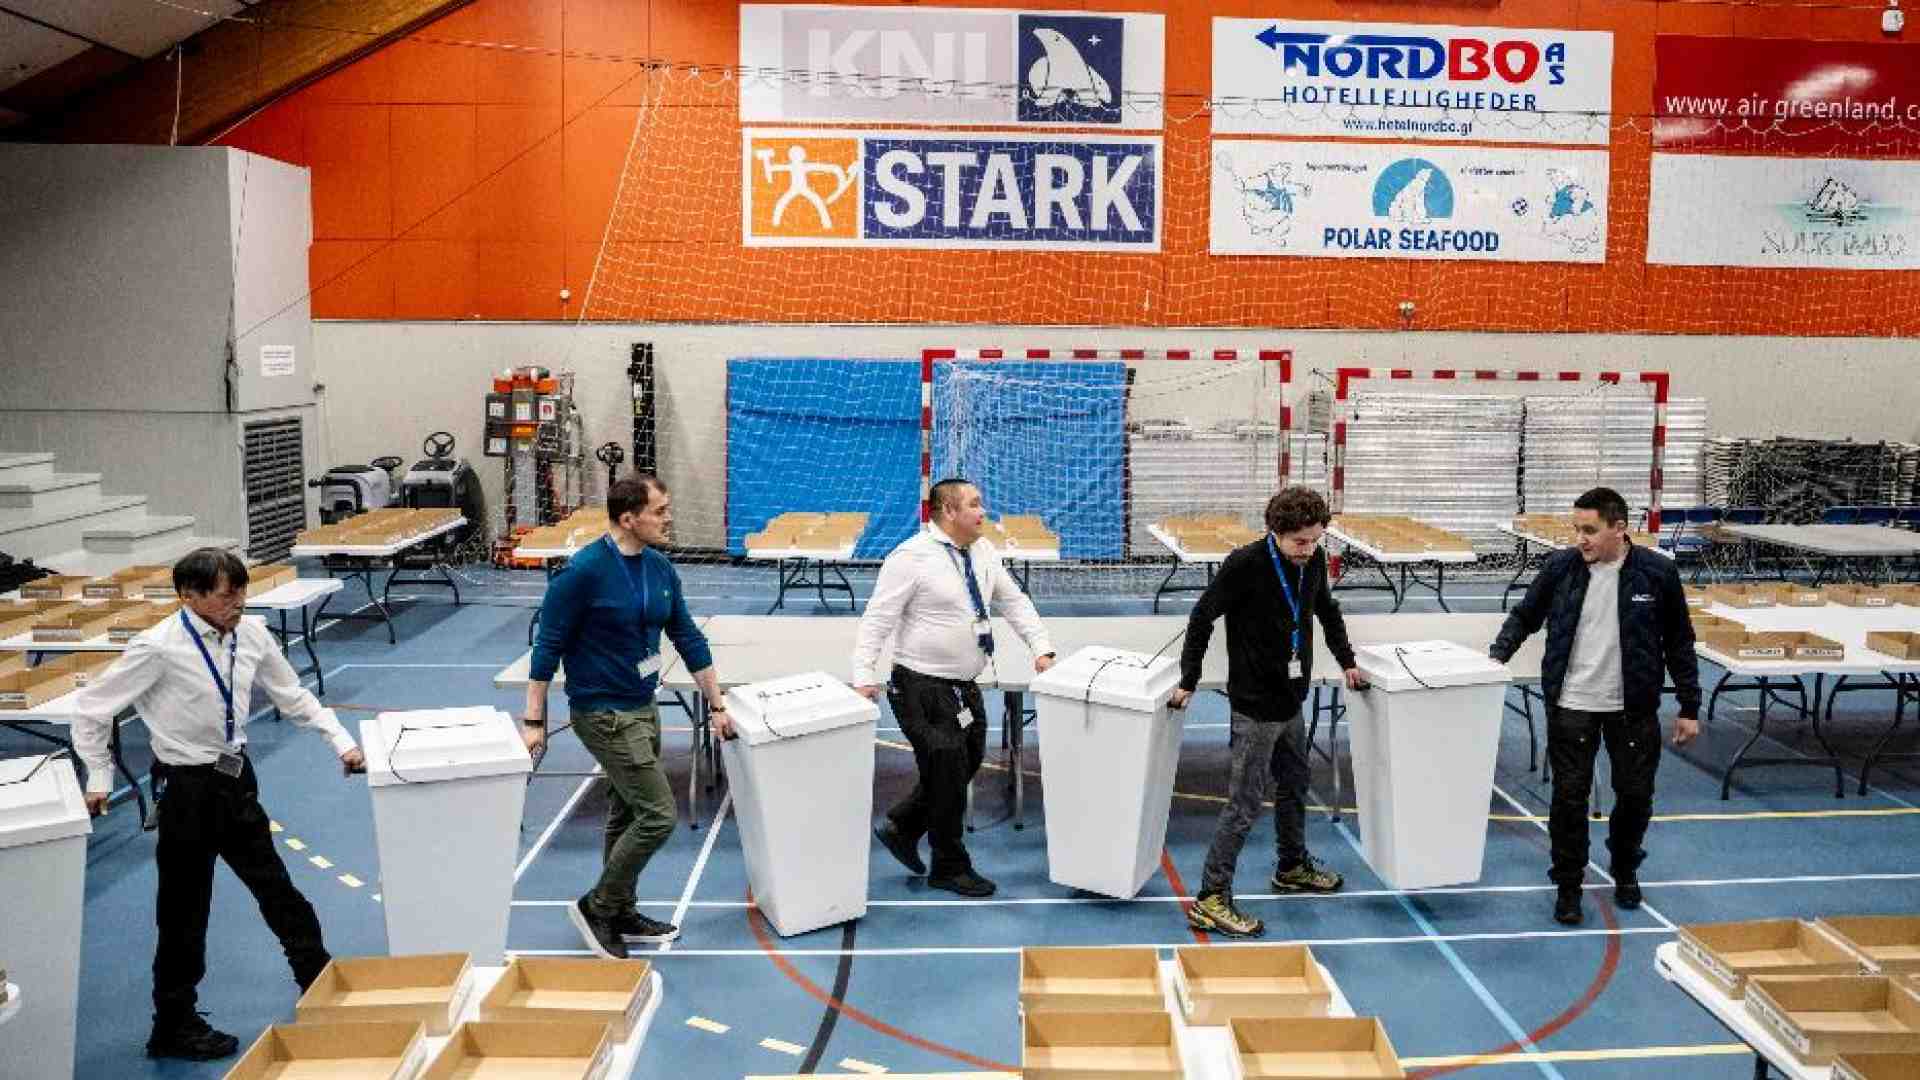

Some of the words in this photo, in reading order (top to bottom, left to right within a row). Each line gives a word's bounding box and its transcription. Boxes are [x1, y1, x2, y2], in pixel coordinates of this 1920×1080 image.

[807, 28, 989, 98] KNI
[1283, 38, 1540, 83] NORDBO
[1283, 86, 1536, 112] HOTELLEJLIGHEDER
[875, 148, 1145, 232] STARK
[1323, 227, 1393, 250] POLAR
[1399, 229, 1499, 252] SEAFOOD
